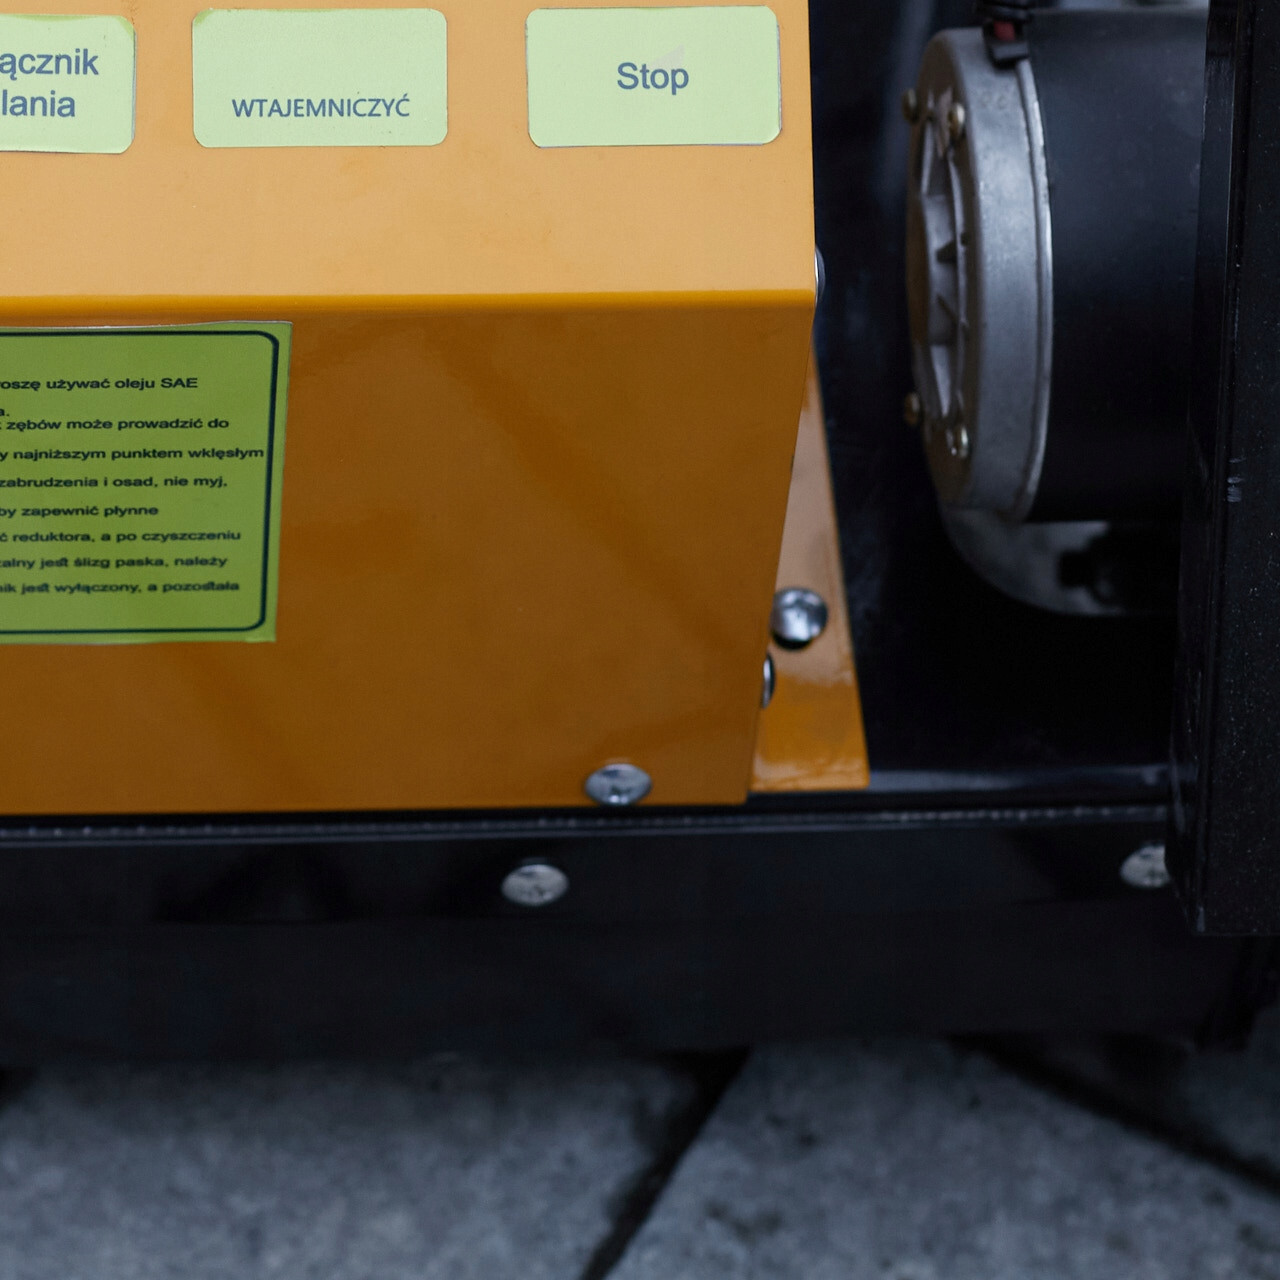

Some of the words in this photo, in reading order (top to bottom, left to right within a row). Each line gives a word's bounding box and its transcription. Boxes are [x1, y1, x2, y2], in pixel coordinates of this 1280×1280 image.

[616, 61, 690, 96] Stop
[231, 93, 411, 118] WTAJEMNICZYĆ
[45, 378, 111, 392] używać
[114, 377, 156, 392] oleju
[160, 377, 199, 389] SAE
[5, 419, 62, 433] zębów
[66, 418, 114, 430] może
[117, 418, 204, 432] prowadzić
[207, 417, 230, 429] do
